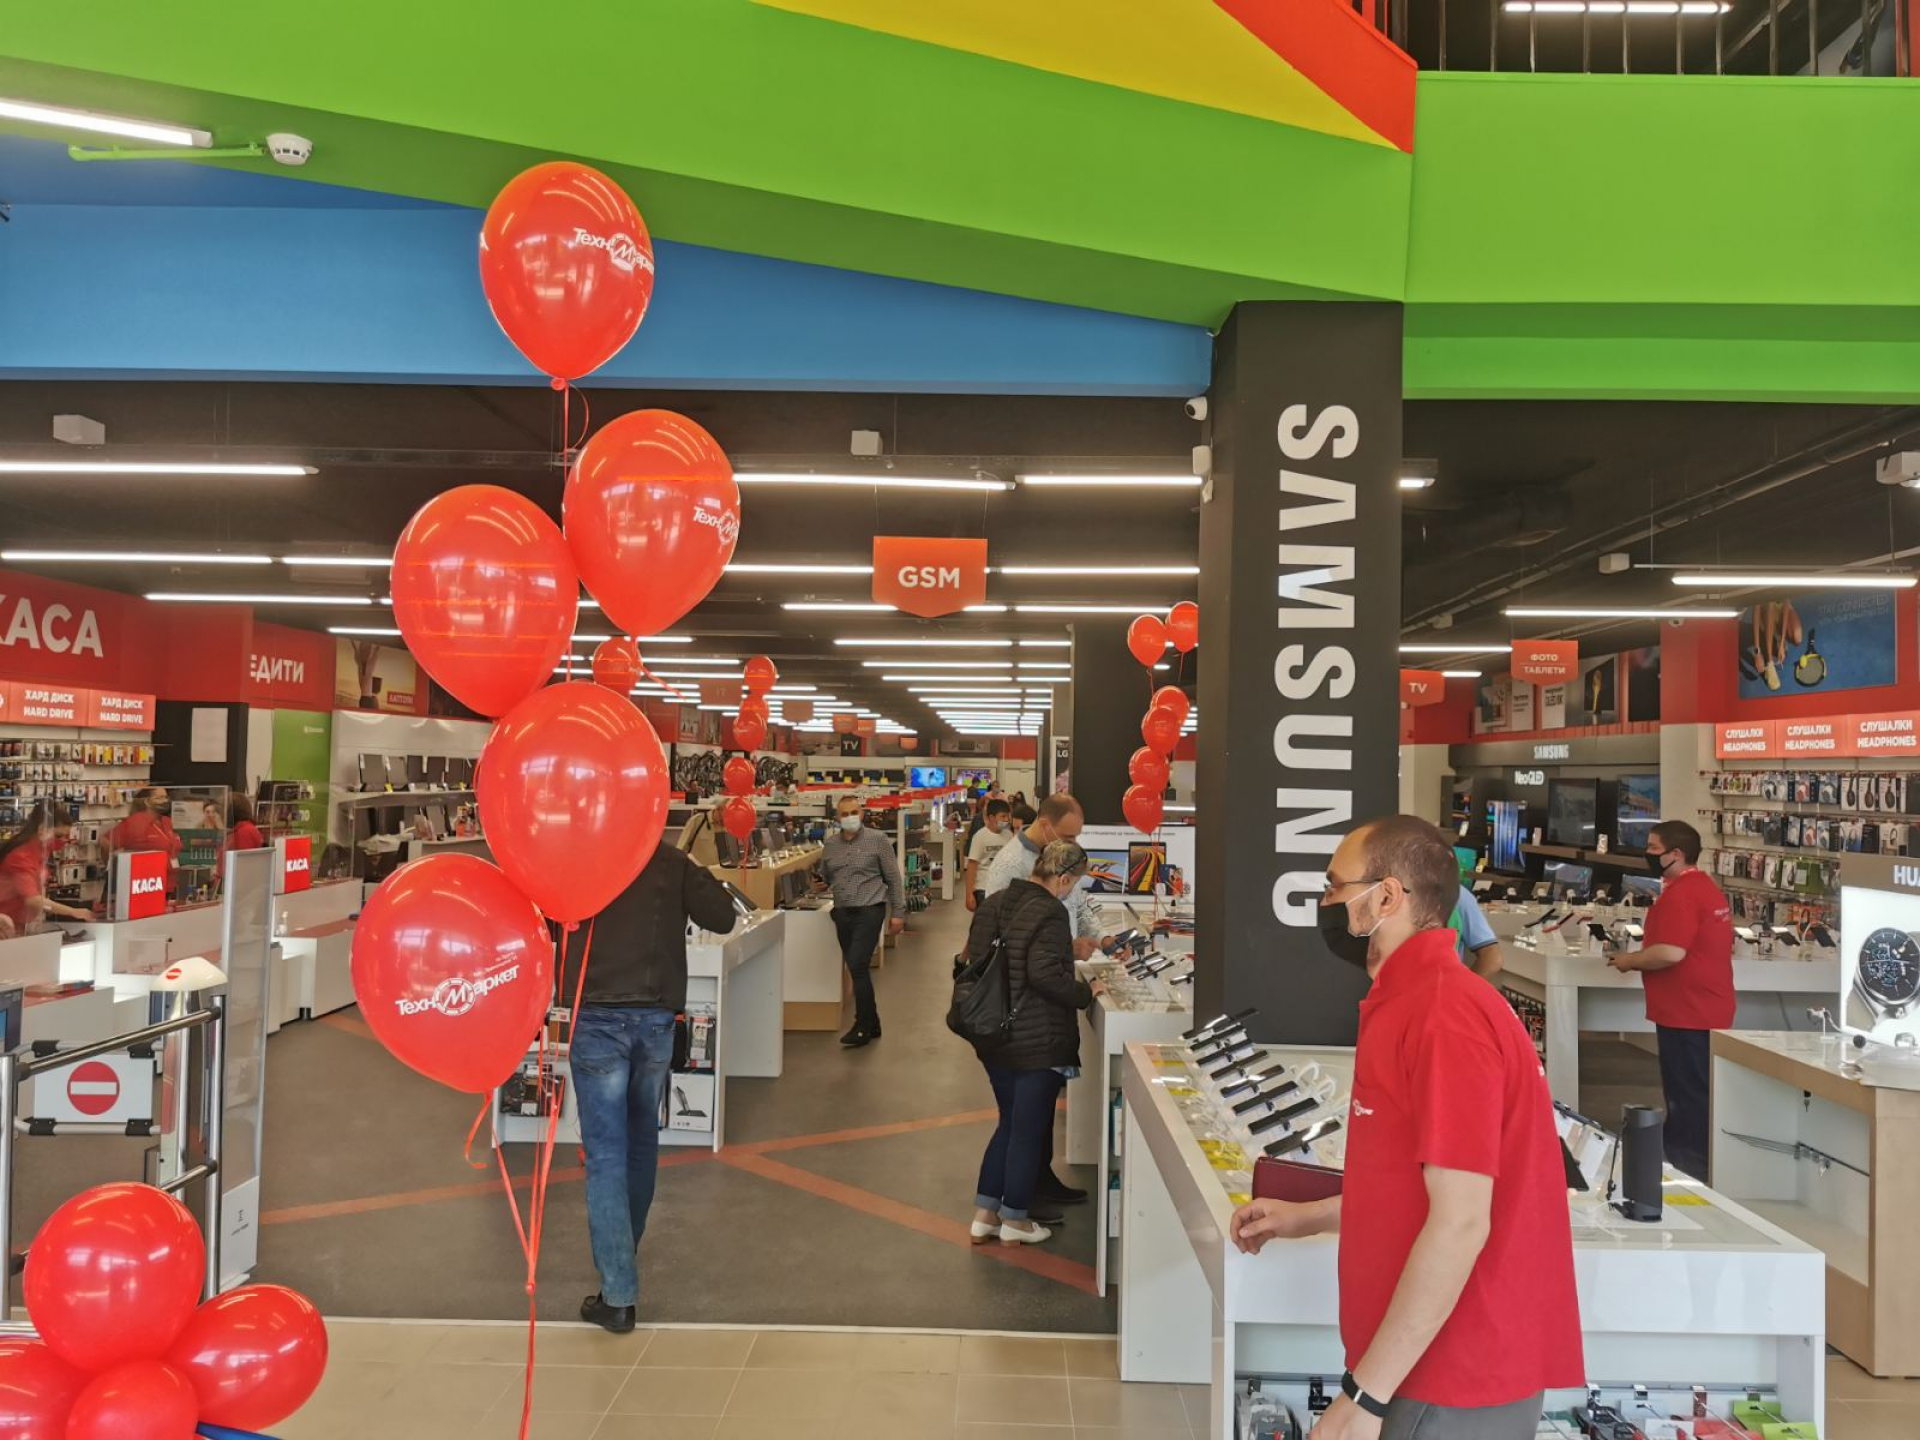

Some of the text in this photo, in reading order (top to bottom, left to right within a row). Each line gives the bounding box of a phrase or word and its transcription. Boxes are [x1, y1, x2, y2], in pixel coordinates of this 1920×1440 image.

[898, 565, 960, 589] GSM
[0, 594, 104, 658] АСА
[1530, 653, 1559, 662] ФОТО
[1271, 404, 1360, 928] SAMSUNG
[1524, 665, 1566, 675] ТАБЛЕТИ
[1409, 682, 1427, 694] TV
[24, 690, 75, 704] ХАРД ДИСК
[101, 696, 144, 710] ХАРД ДИСК
[23, 706, 75, 719] HARD DRIVE
[100, 711, 144, 724] HARD DRIVE
[1787, 724, 1832, 736] СЛУШАЛКИ
[1860, 719, 1913, 733] СЛУШАЛКИ
[1725, 728, 1764, 739] СЛУШАЛКИ
[1723, 741, 1767, 752] HEADPHONES
[1785, 738, 1835, 750] HEADPHONES
[1857, 735, 1917, 748] HEADPHONES
[1057, 750, 1069, 758] LG
[1534, 744, 1569, 760] SAMSUNG
[286, 858, 309, 872] КАСА
[1893, 864, 1920, 887] HU
[131, 876, 163, 894] КАСА
